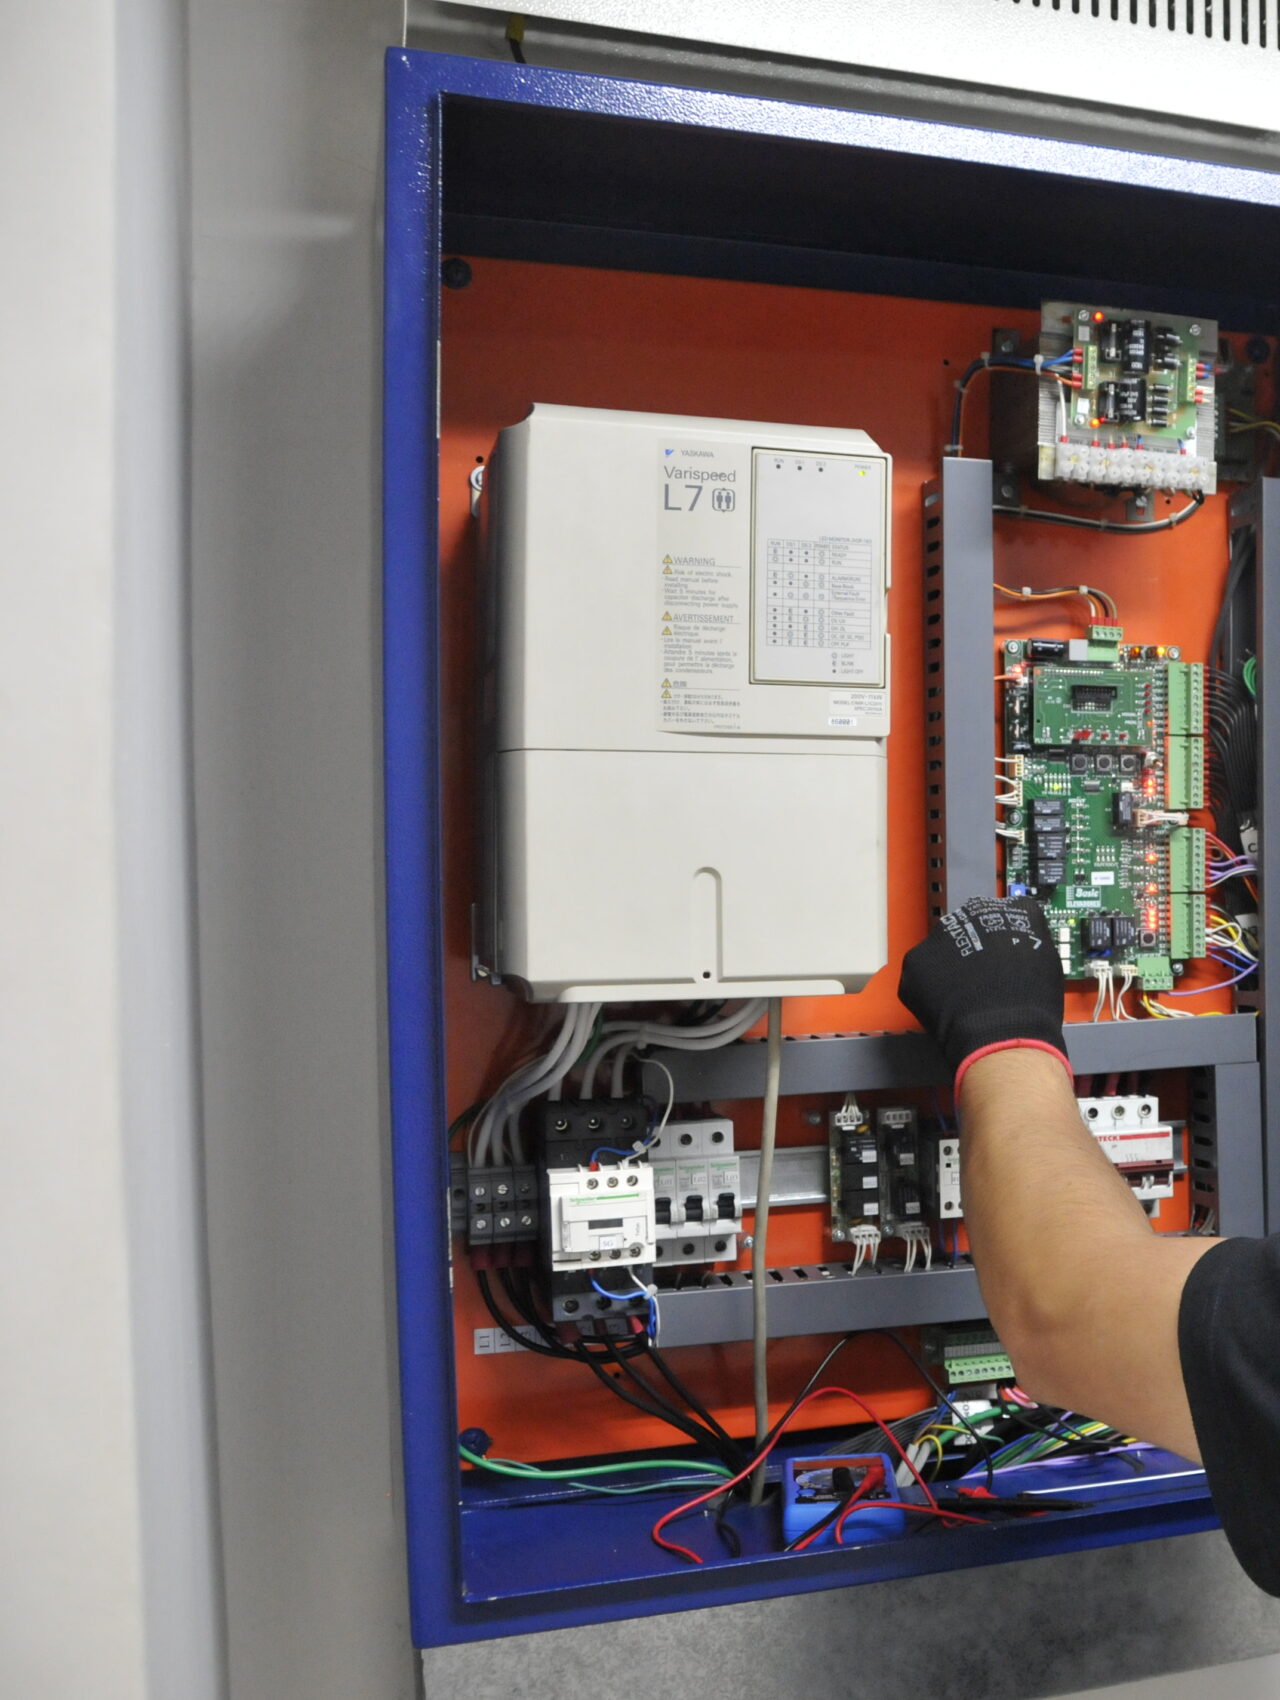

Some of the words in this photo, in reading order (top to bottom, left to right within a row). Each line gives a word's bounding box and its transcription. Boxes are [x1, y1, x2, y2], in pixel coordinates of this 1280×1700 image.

[681, 449, 715, 458] YASKAWA
[664, 465, 736, 483] Varispeed
[664, 483, 703, 512] L7
[673, 556, 716, 566] WARNING
[673, 614, 734, 624] AVERTISSEMENT
[1075, 888, 1099, 898] Basic
